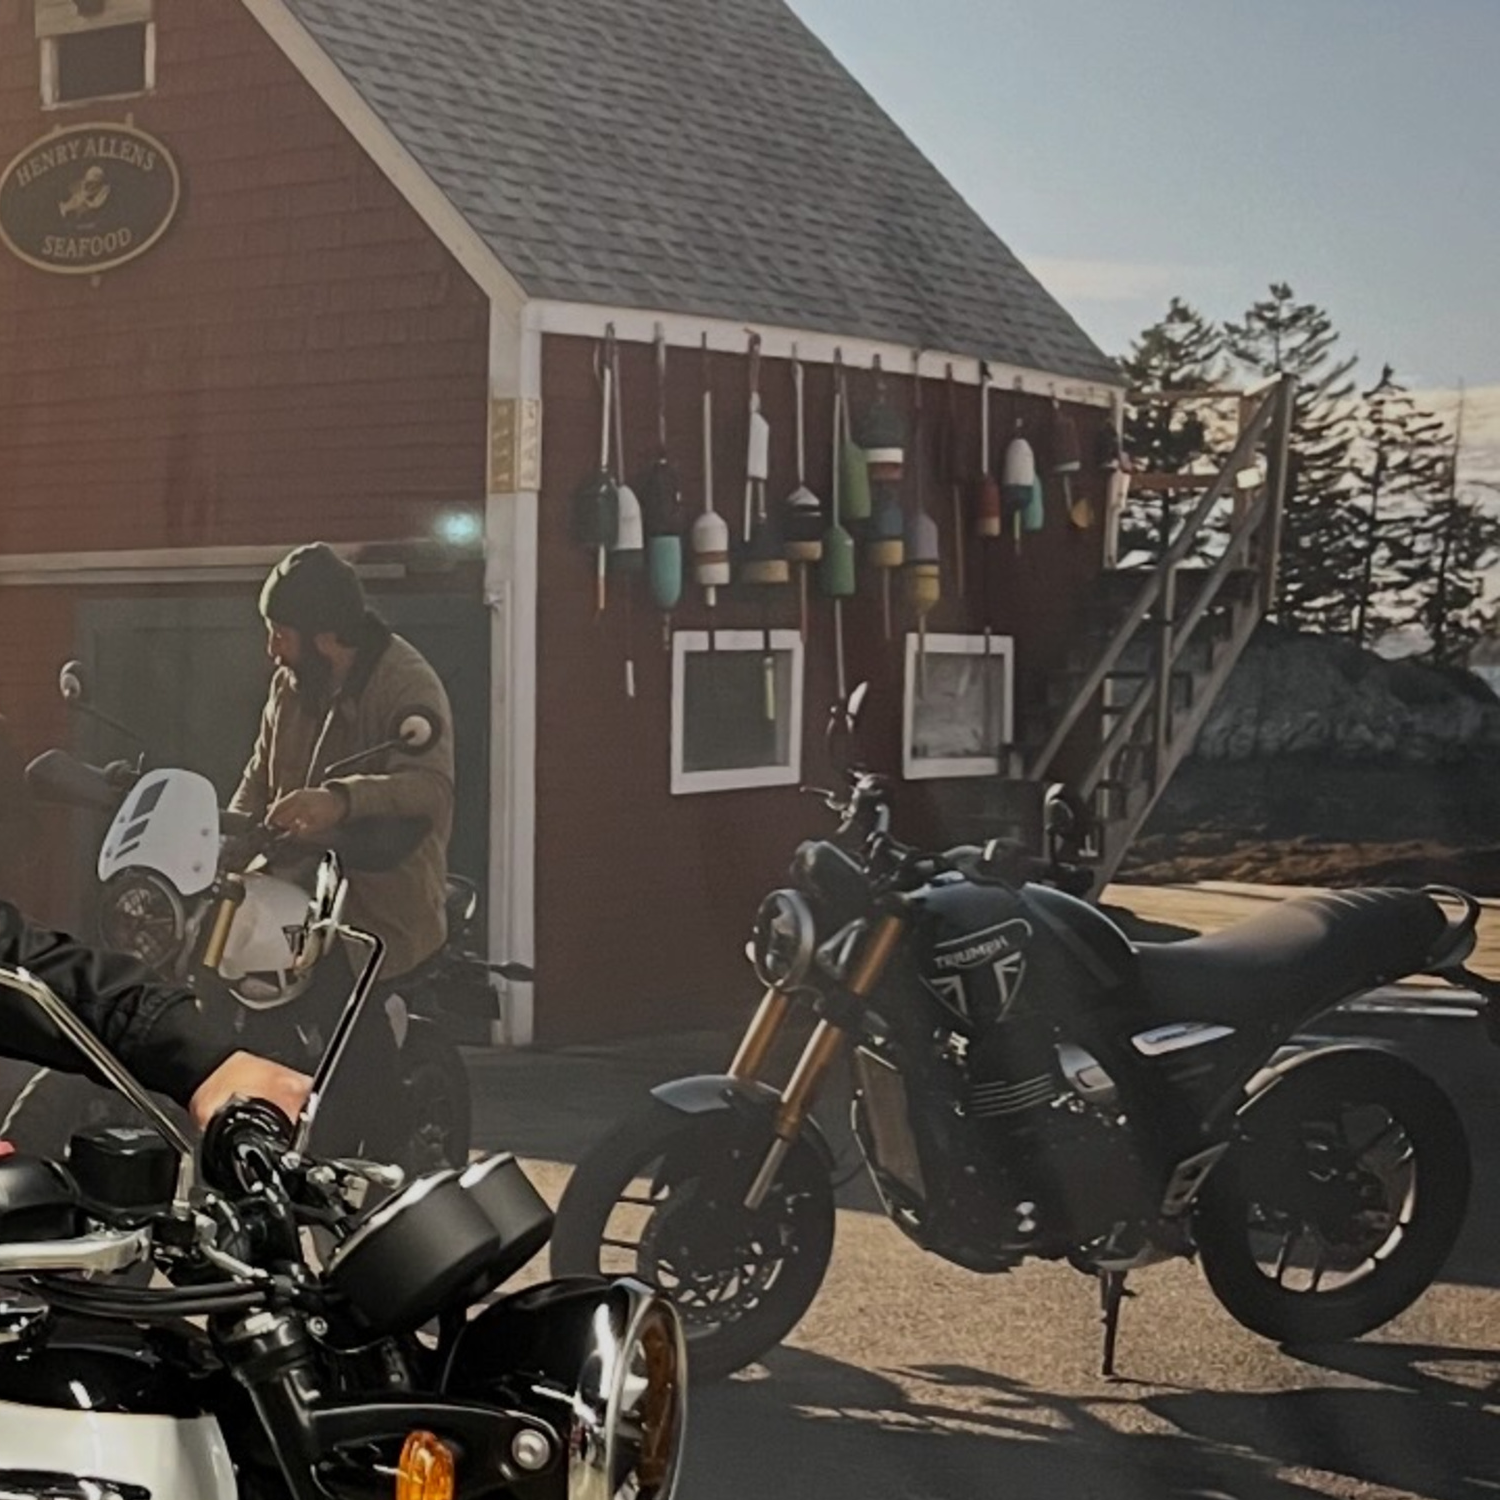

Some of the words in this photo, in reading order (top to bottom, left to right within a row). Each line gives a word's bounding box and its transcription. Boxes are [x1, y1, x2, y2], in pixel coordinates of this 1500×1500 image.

[16, 141, 80, 187] HENRY
[83, 138, 157, 171] ALLENS
[42, 227, 132, 258] SEAFOOD
